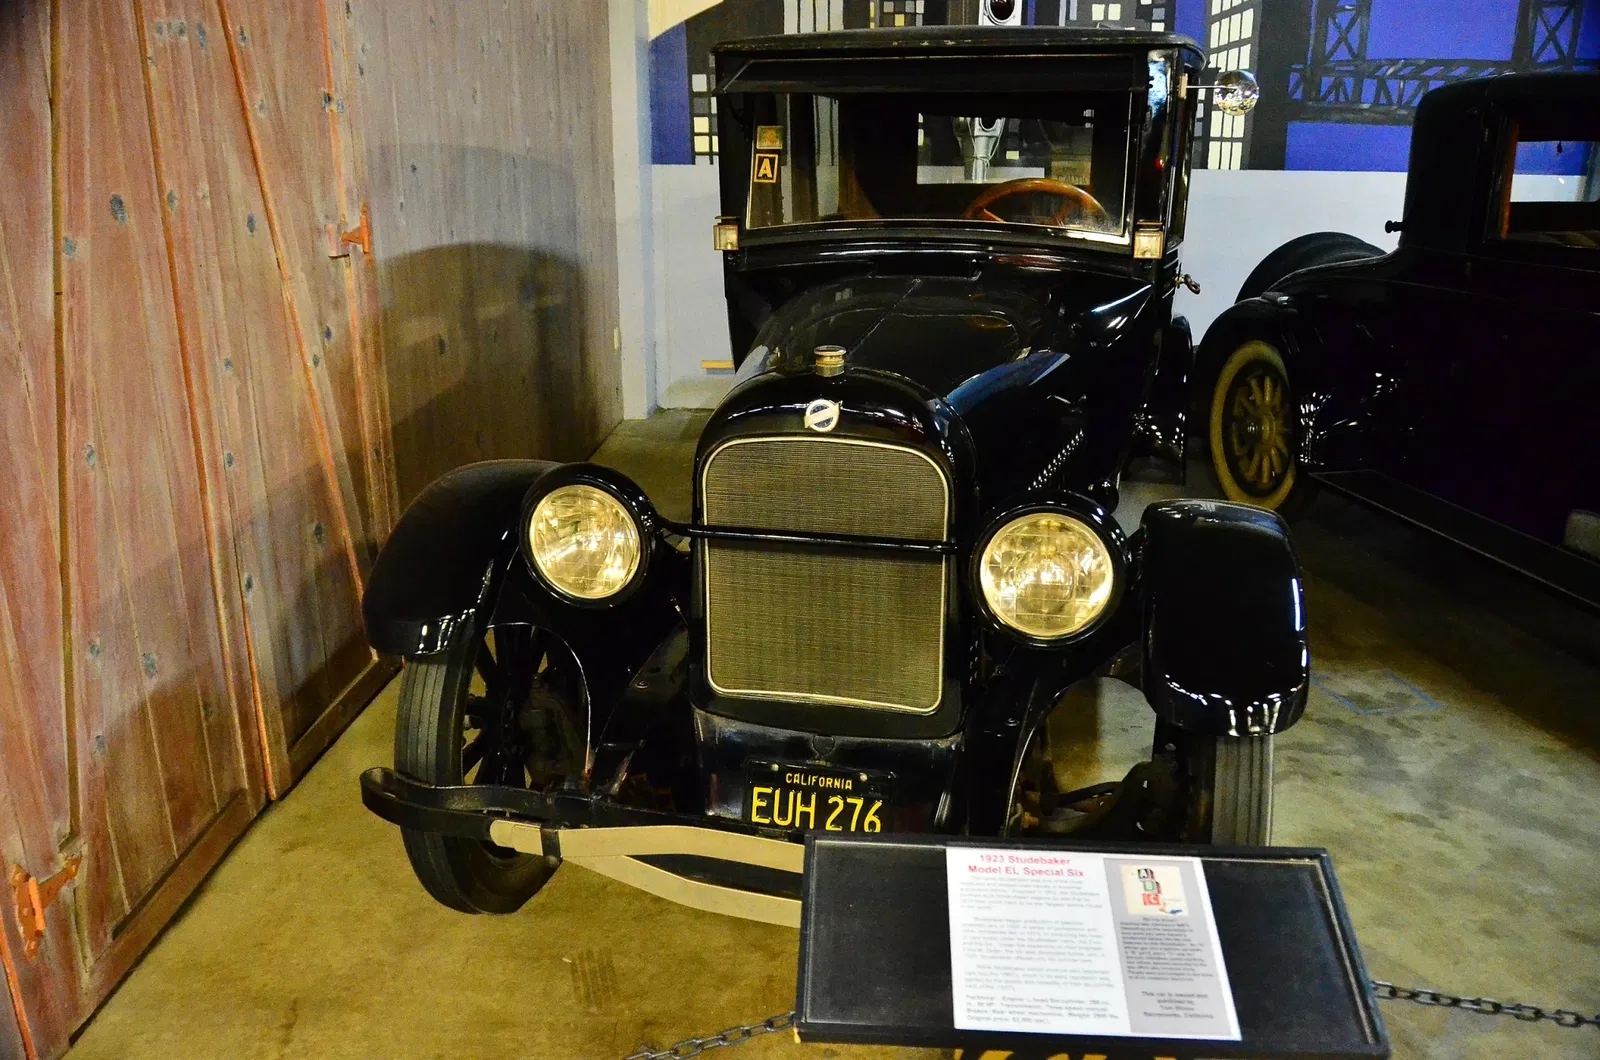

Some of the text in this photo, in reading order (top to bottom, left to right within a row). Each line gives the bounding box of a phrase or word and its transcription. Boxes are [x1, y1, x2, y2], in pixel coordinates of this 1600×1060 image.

[757, 158, 773, 178] A
[785, 772, 853, 791] CALIFORNIA
[751, 786, 883, 833] EUH 276
[980, 855, 1071, 866] 1923 Studebaker
[968, 865, 1085, 877] Model EL Special Six
